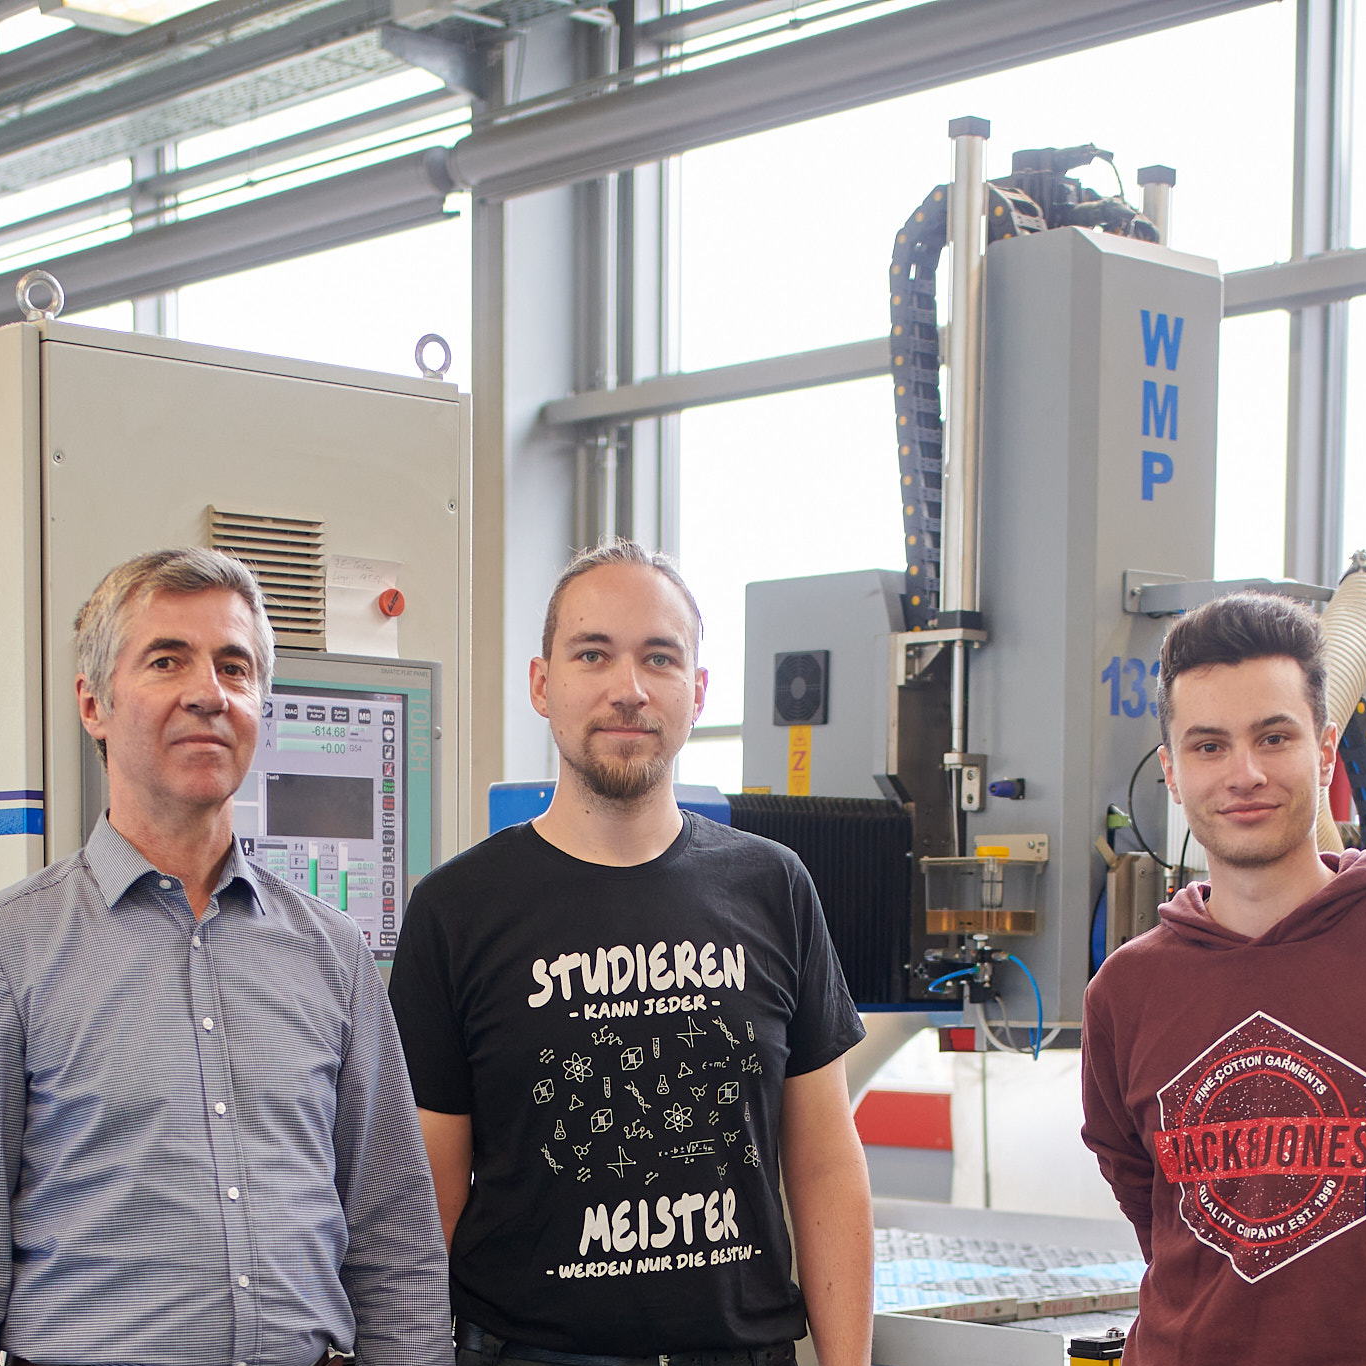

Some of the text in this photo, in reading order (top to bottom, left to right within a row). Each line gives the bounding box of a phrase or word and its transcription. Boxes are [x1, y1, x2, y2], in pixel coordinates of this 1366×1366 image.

[380, 667, 429, 678] SIMATIC FLAT PANEL
[358, 711, 371, 721] M8
[383, 714, 395, 724] M3
[266, 723, 271, 731] Y
[311, 725, 346, 738] -614.68
[410, 696, 430, 772] TOUCH
[266, 739, 271, 748] A
[321, 742, 346, 754] +0.00
[528, 940, 745, 1008] STUDIEREN
[584, 999, 638, 1020] KANN
[644, 994, 707, 1016] JEDER
[1194, 1055, 1328, 1104] FINE COTTON GARMENTS
[1199, 1184, 1235, 1228] QUALITY
[1288, 1208, 1316, 1231] EST.
[1314, 1179, 1337, 1208] 1990
[579, 1187, 739, 1256] MEISTER
[558, 1259, 632, 1279] WERDEN
[636, 1255, 673, 1275] NUR
[676, 1250, 706, 1269] DIE
[710, 1245, 752, 1266] BESTEN
